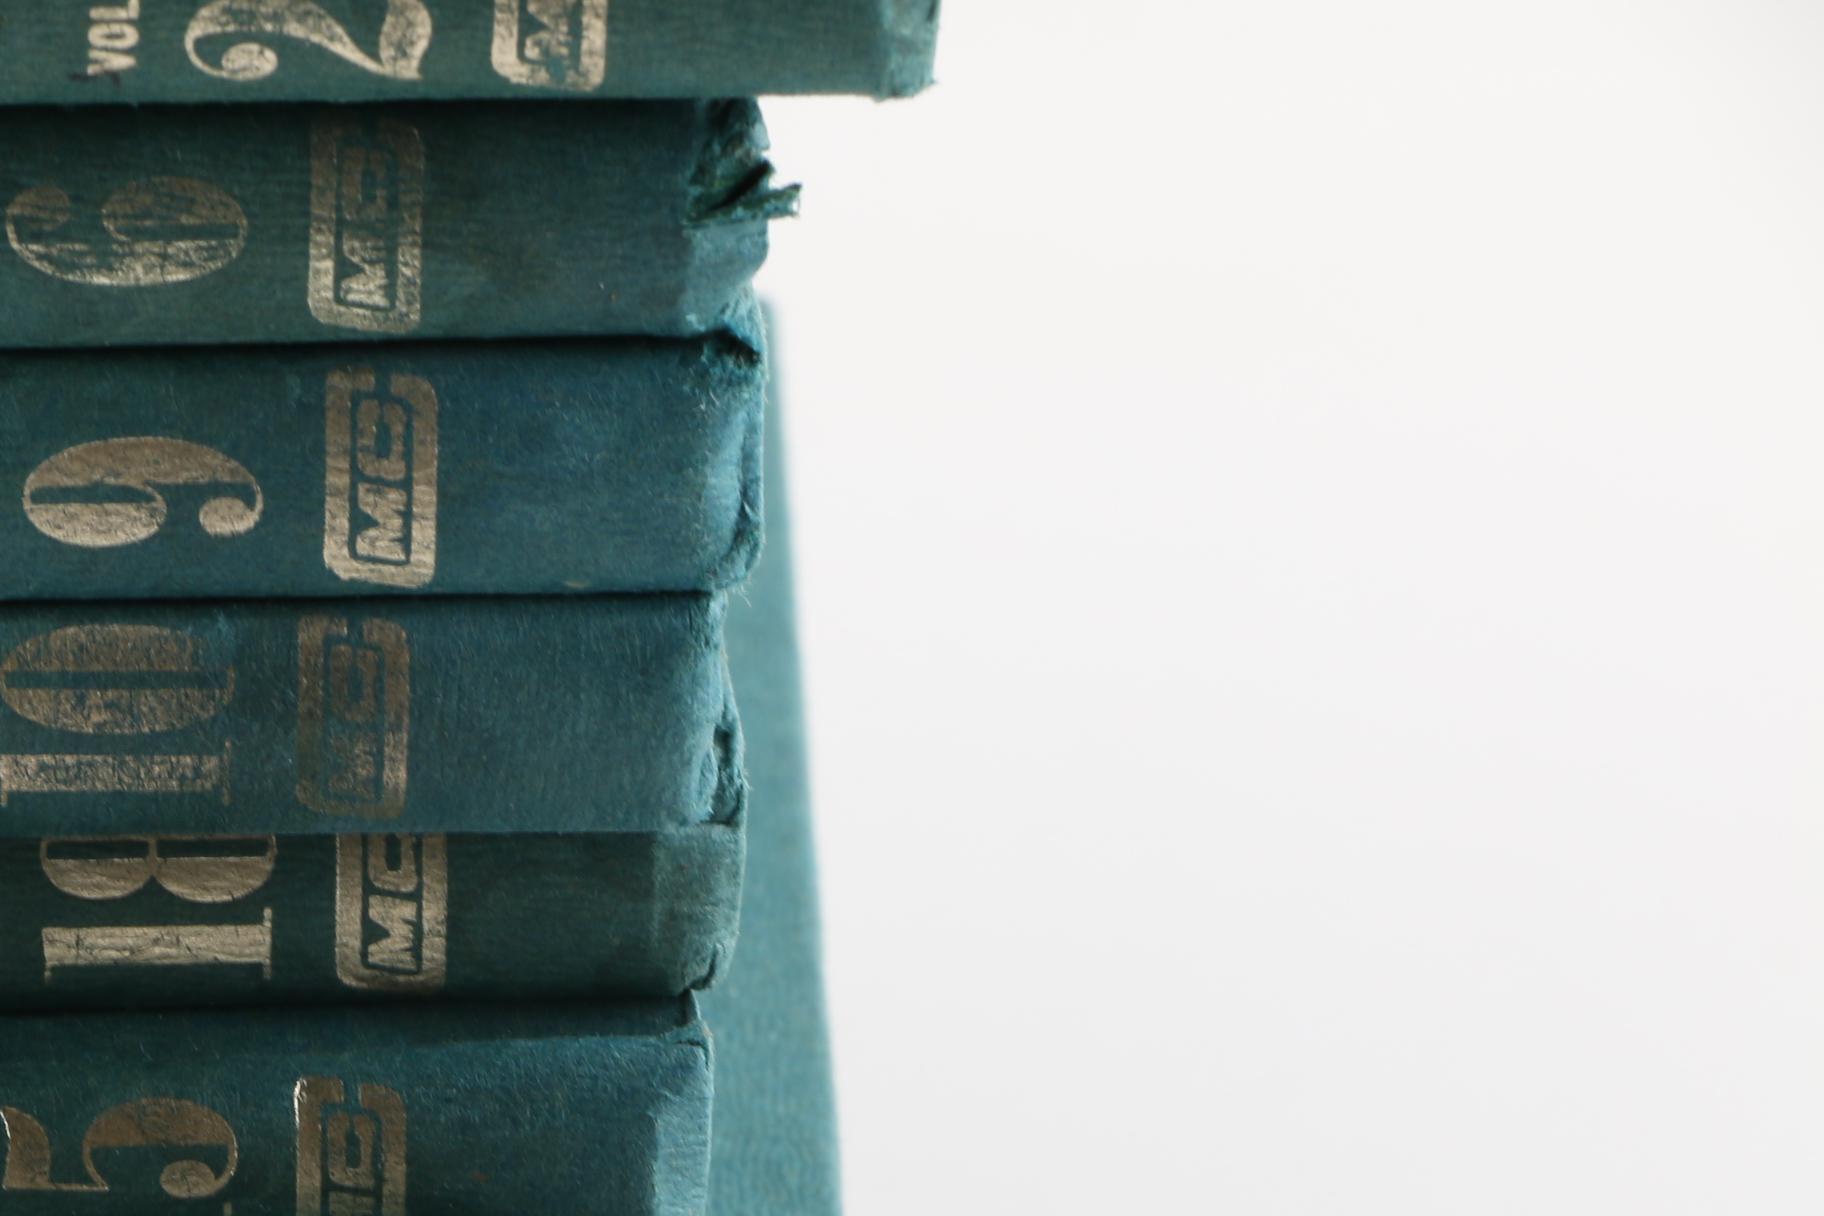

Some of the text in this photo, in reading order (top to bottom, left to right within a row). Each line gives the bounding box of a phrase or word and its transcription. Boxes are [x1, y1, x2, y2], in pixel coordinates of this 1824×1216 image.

[5, 176, 249, 286] 6
[22, 435, 264, 549] 9
[39, 834, 278, 979] 18
